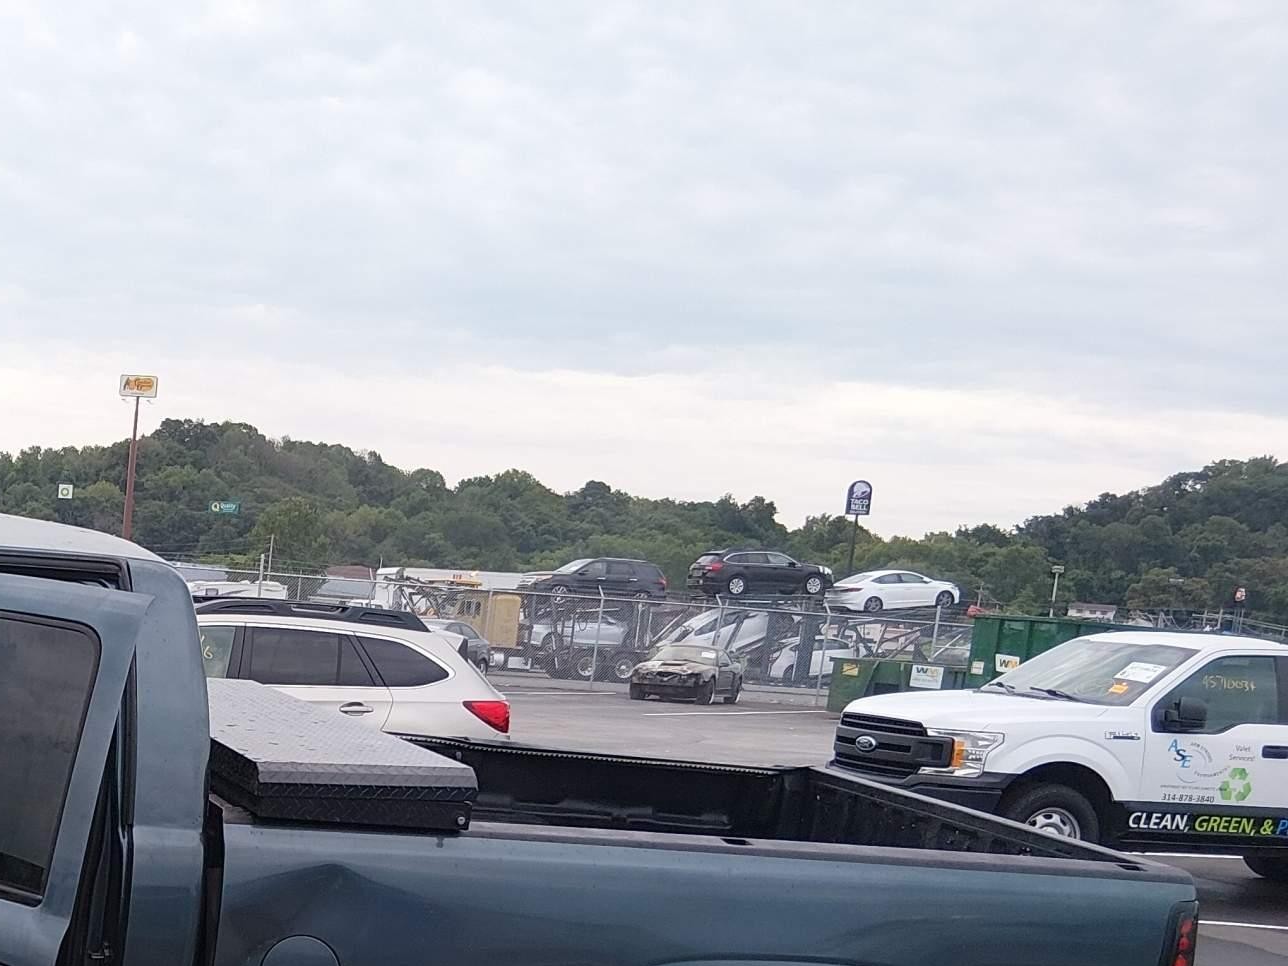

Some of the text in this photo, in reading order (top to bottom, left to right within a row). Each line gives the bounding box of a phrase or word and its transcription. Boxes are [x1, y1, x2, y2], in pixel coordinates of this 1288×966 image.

[1128, 812, 1190, 833] CLEAN,
[1194, 816, 1256, 836] GREEN,
[1260, 819, 1274, 835] &
